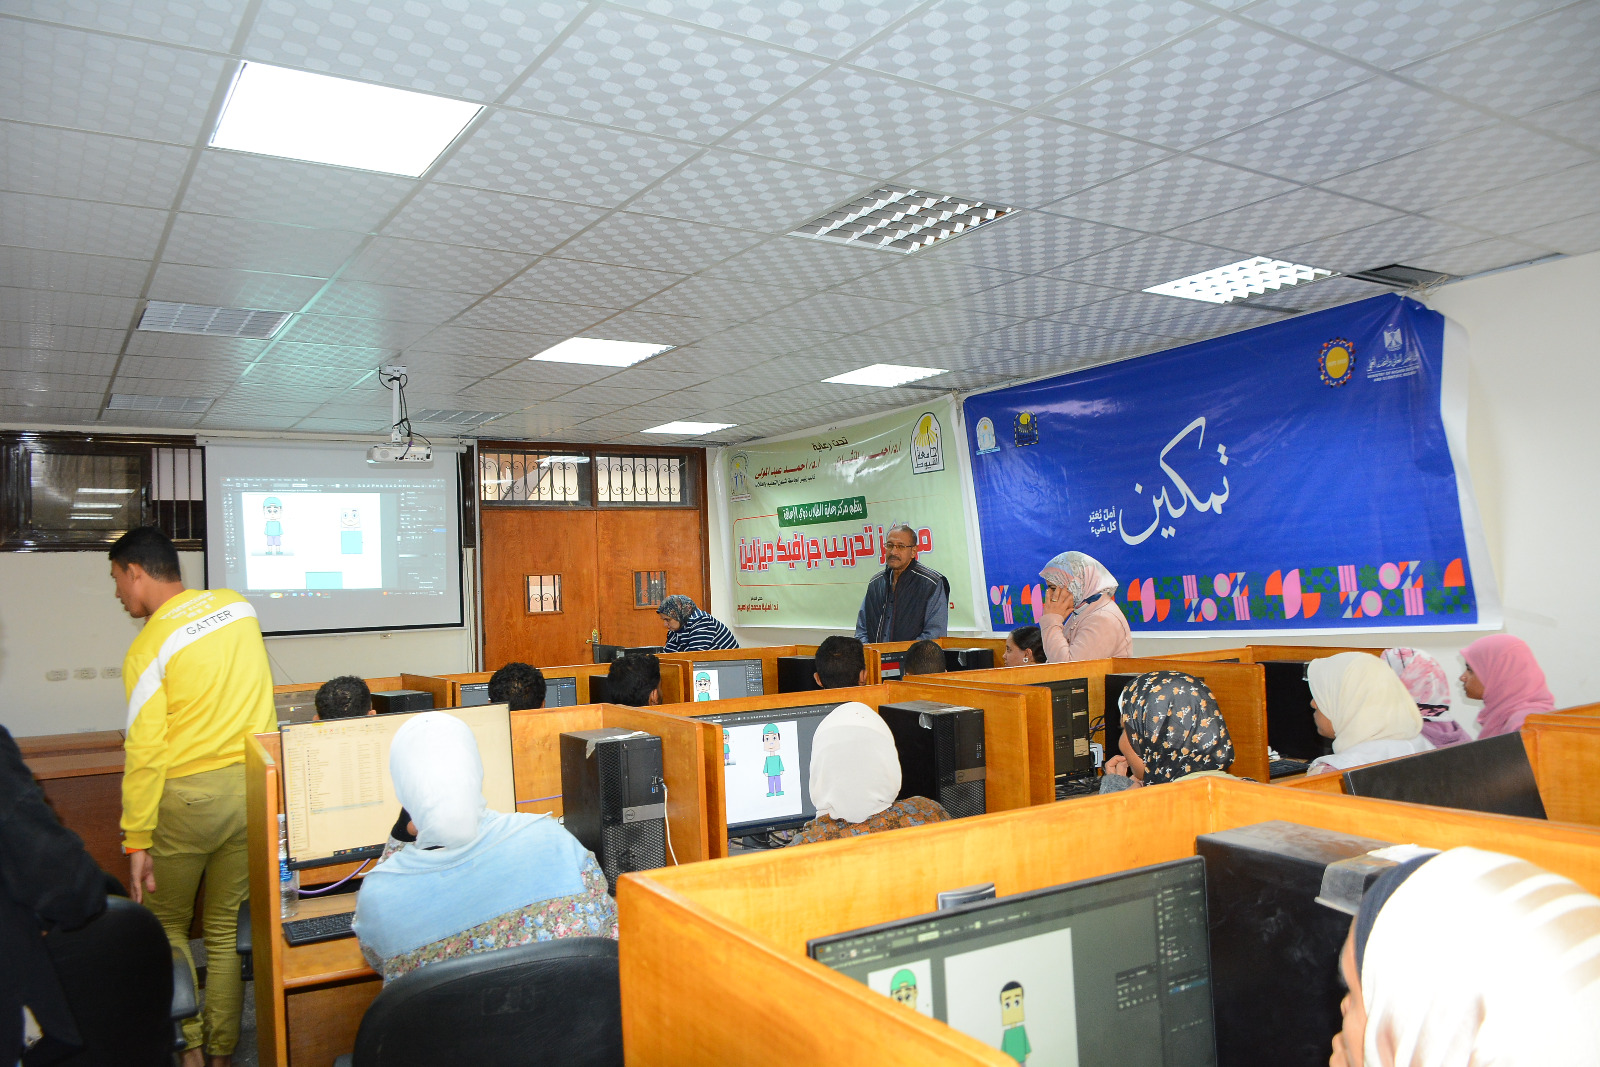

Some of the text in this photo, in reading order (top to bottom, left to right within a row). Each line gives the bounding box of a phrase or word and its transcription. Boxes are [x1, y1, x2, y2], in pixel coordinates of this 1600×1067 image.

[811, 436, 848, 452] تحت رعاية
[770, 467, 782, 477] عبد
[1119, 416, 1229, 546] تمكين
[808, 503, 824, 520] الطلاب
[837, 500, 849, 516] مركز
[849, 499, 863, 515] ينظم
[1090, 520, 1117, 538] كل شيء
[738, 523, 934, 572] مز تدريب جرافيك ديزاين
[186, 609, 234, 635] GATTER
